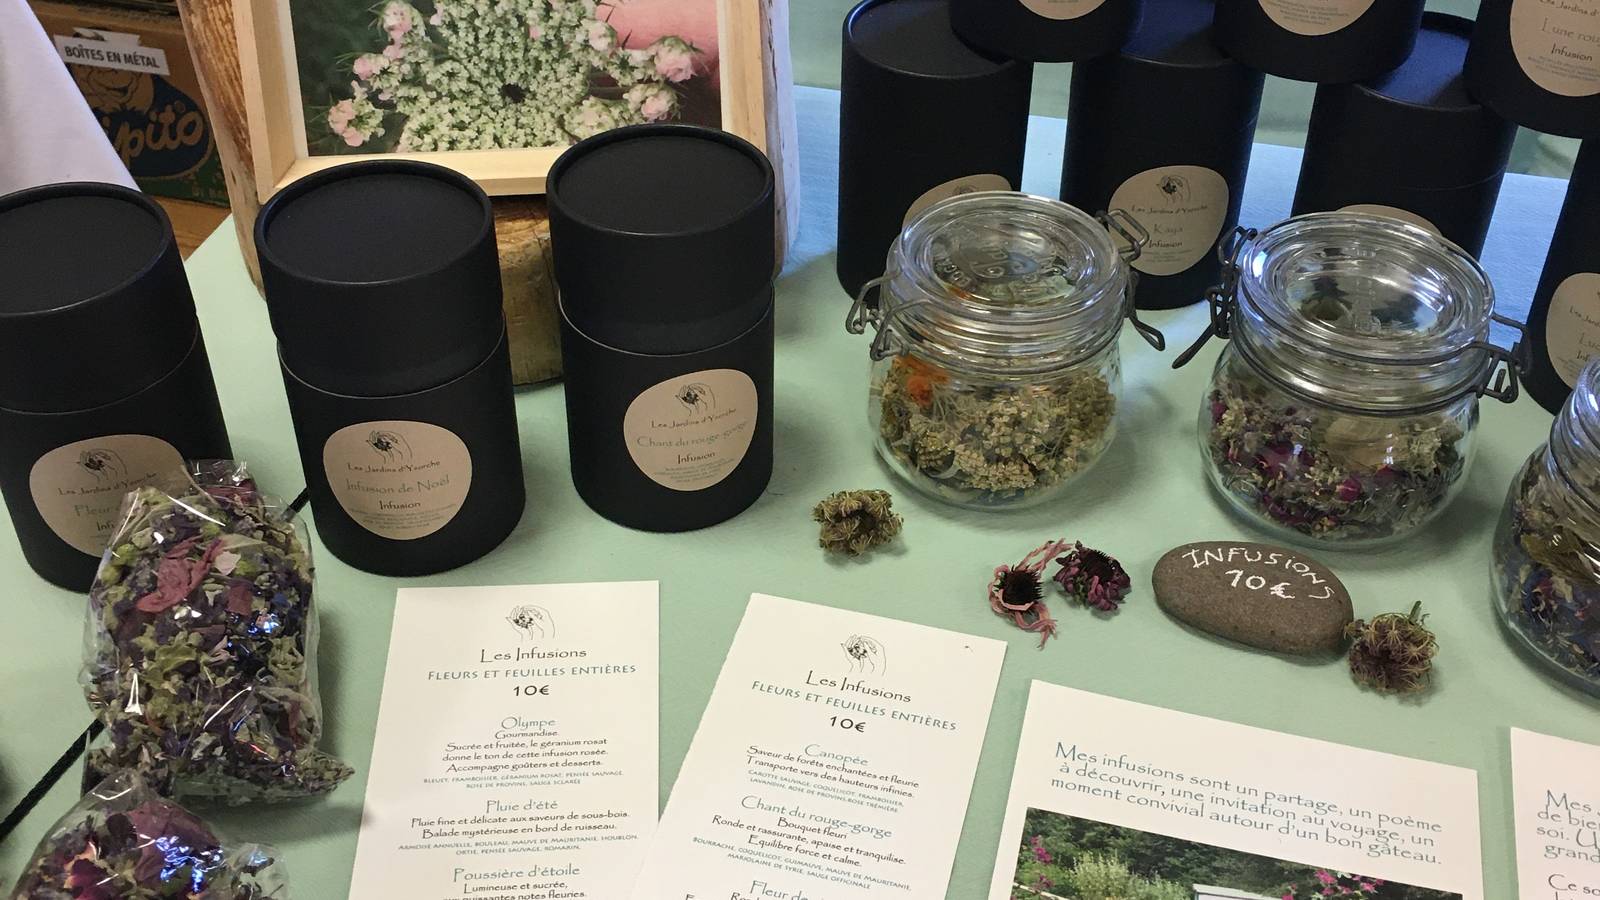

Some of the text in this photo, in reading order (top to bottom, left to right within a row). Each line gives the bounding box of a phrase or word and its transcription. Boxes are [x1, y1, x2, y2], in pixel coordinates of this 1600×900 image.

[1542, 17, 1574, 38] Lune
[65, 44, 160, 68] BOÎTES EN MÉTAL
[1551, 43, 1593, 62] Infusion
[637, 436, 673, 447] Chant
[675, 438, 689, 447] du
[347, 461, 362, 471] Les
[677, 452, 716, 465] Infusion
[346, 474, 450, 494] Infusion de Noël
[379, 500, 421, 511] Infusion
[480, 646, 587, 663] Les Infusions
[428, 663, 636, 681] FLEURS ET FEUILLES ENTIÈRES
[513, 684, 550, 697] 10€
[805, 670, 911, 703] Les Infusions
[751, 680, 956, 731] FLEURS ET FEUILLES ENTIÈRES
[501, 716, 556, 732] Olympe
[830, 716, 866, 733] 10€
[445, 743, 482, 753] Sucrée
[495, 740, 529, 749] fruitée,
[530, 738, 538, 747] le
[539, 740, 582, 750] géranium
[442, 753, 472, 762] donne
[473, 751, 482, 760] le
[501, 750, 514, 759] de
[541, 748, 579, 757] infusion
[580, 748, 608, 756] rosée.
[804, 744, 869, 769] Canopée
[446, 763, 510, 774] Accompagne
[510, 761, 548, 772] goûters
[746, 745, 783, 761] Saveur
[783, 753, 795, 762] de
[796, 755, 824, 768] forêts
[825, 763, 878, 779] enchantées
[890, 774, 919, 788] fleurie
[747, 755, 799, 774] Transporte
[800, 769, 819, 778] vers
[820, 771, 837, 782] des
[838, 774, 879, 790] hauteurs
[1055, 741, 1442, 833] Mes infusions sont un partage, un poème
[486, 798, 558, 814] Pluie d'été
[1059, 761, 1434, 847] à découvrir, une invitation au voyage, un
[1546, 789, 1592, 812] Mes
[411, 817, 436, 829] Pluie
[437, 816, 456, 826] fine
[469, 815, 508, 825] délicate
[566, 811, 579, 820] de
[741, 796, 892, 840] Chant du rouge-gorge
[1051, 779, 1442, 865] moment convivial autour d'un bon gâteau.
[1537, 805, 1562, 822] de
[422, 827, 460, 840] Balade
[461, 827, 519, 839] mystérieuse
[535, 823, 559, 833] bord
[560, 822, 573, 832] de
[711, 814, 745, 829] Ronde
[757, 827, 809, 845] rassurante,
[810, 839, 842, 851] apaise
[777, 817, 848, 839] Bouquet fleuri
[1536, 826, 1570, 841] soi.
[747, 834, 793, 852] Equilibre
[794, 844, 820, 858] force
[453, 862, 580, 883] Poussière d'étoile
[463, 883, 518, 894] Lumineuse
[532, 880, 568, 890] sucrée,
[749, 880, 789, 900] Fleur
[1548, 873, 1577, 891] Ce
